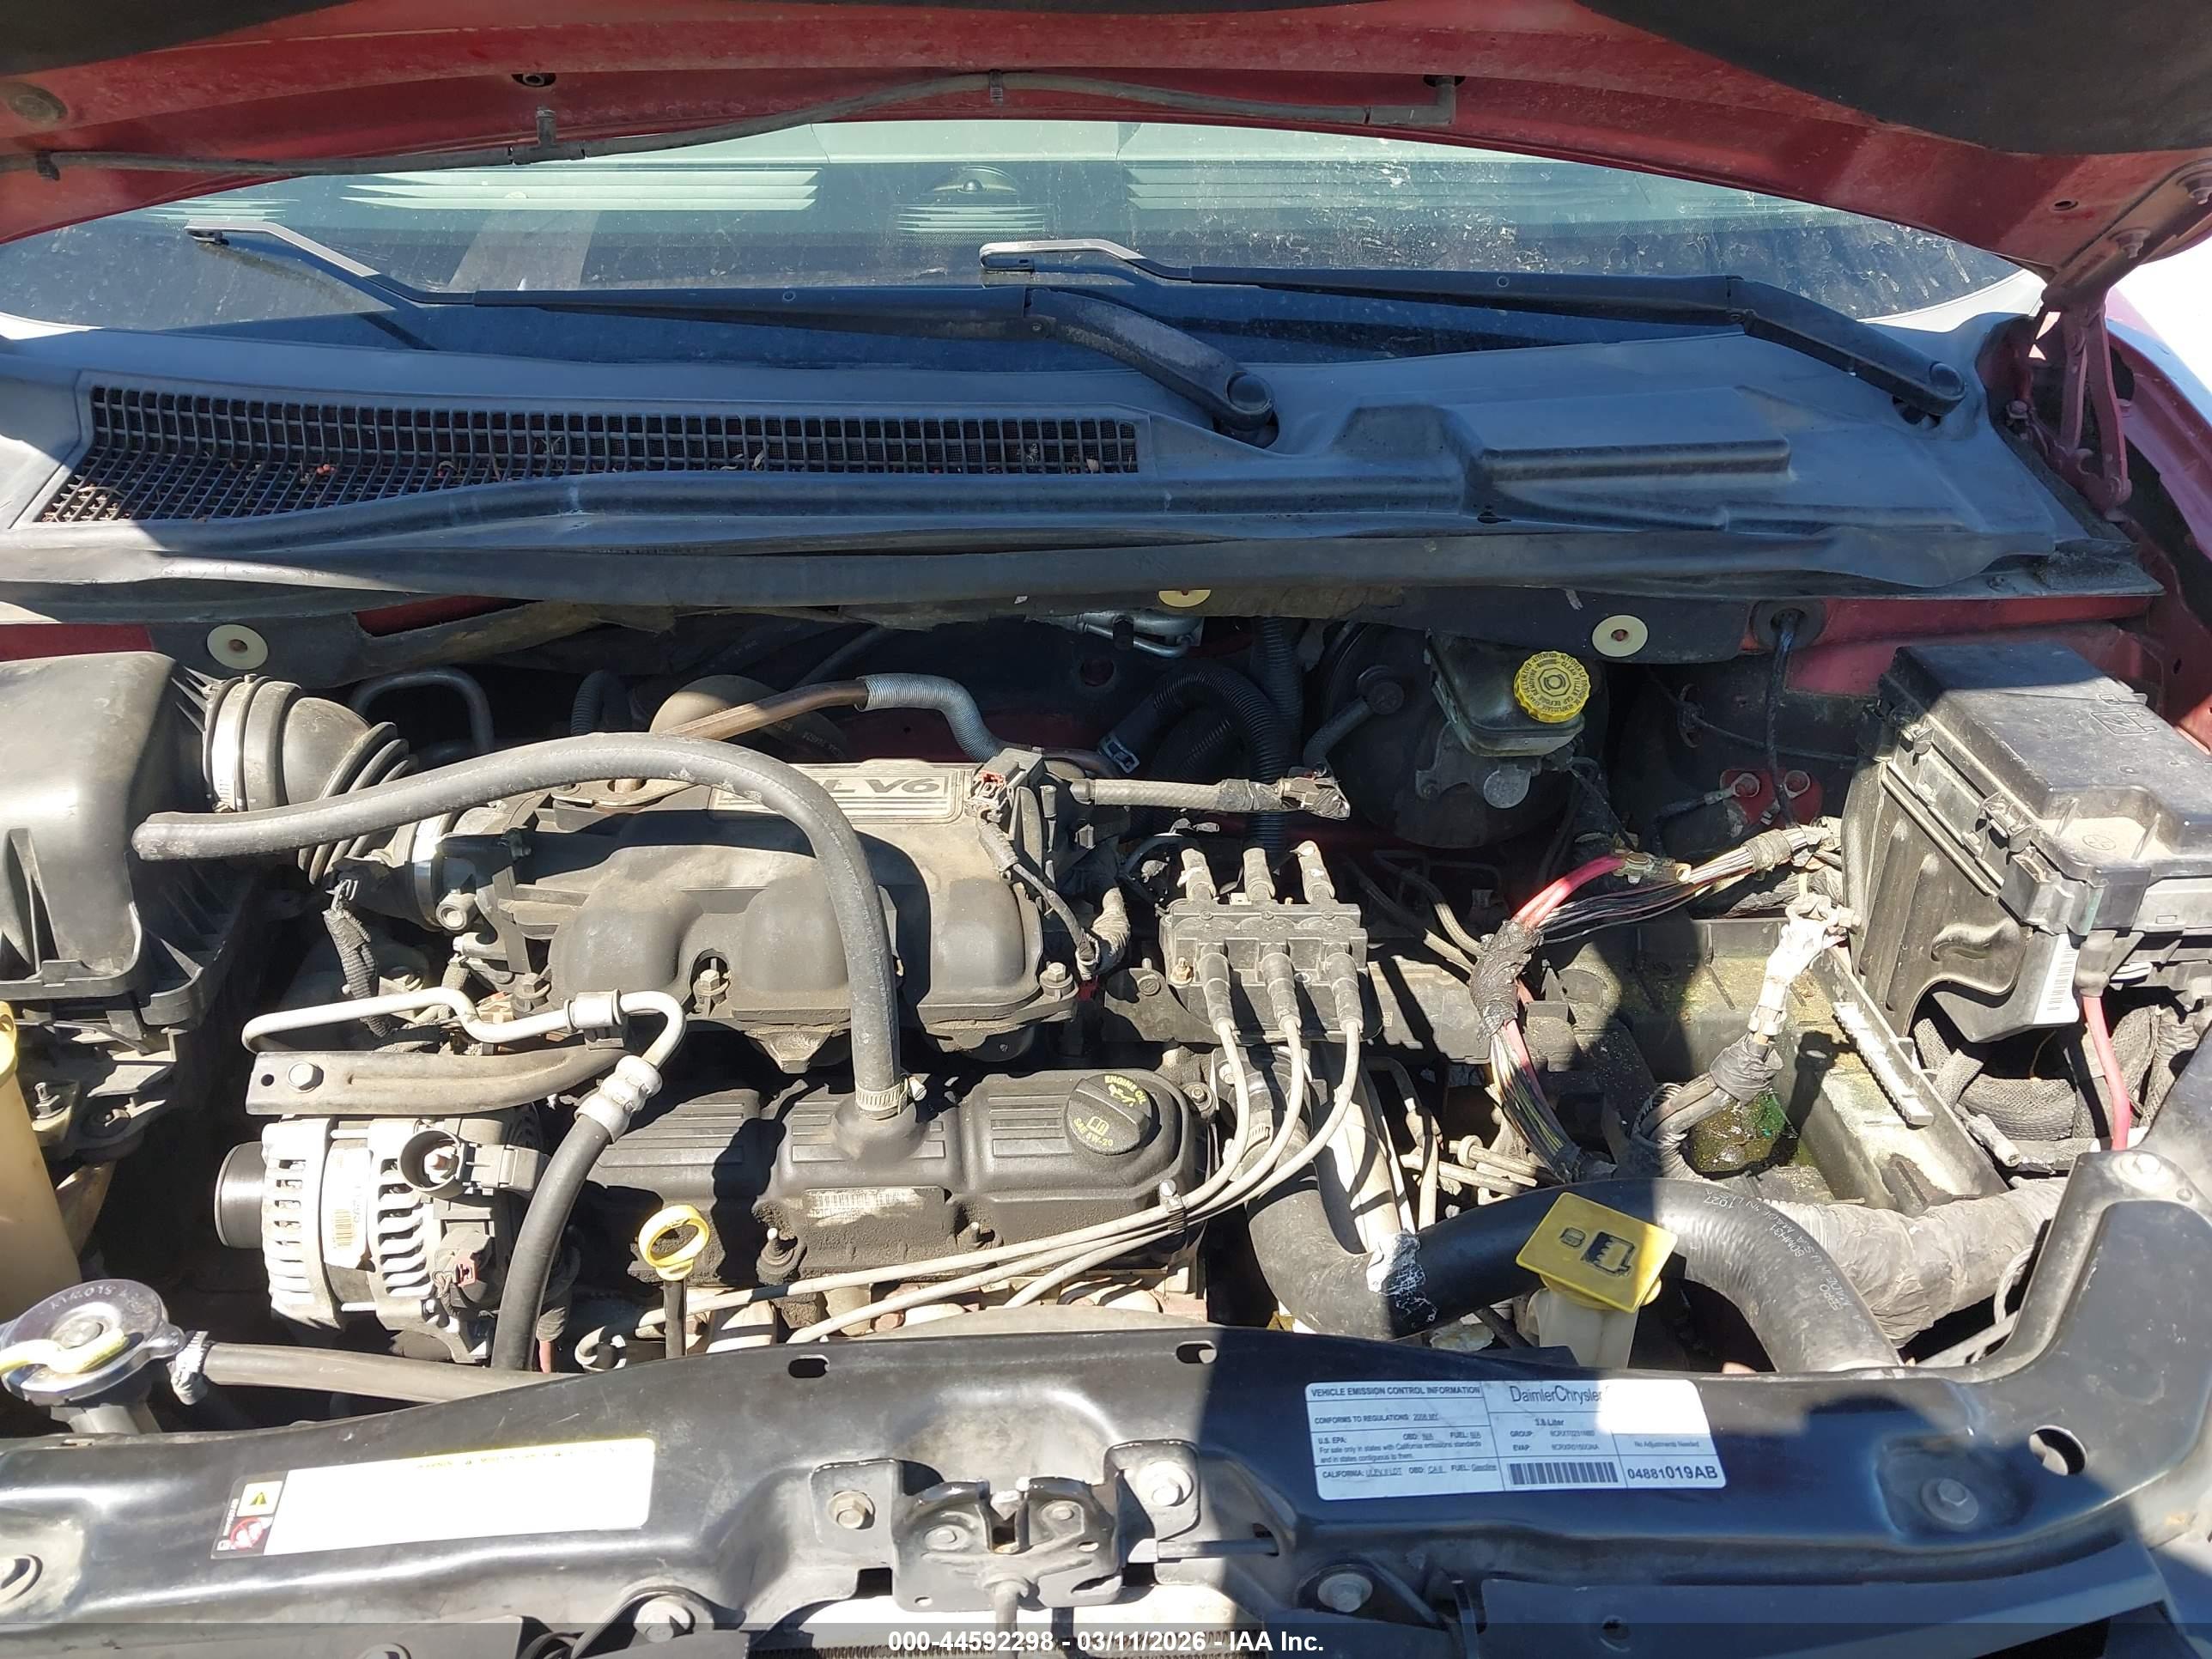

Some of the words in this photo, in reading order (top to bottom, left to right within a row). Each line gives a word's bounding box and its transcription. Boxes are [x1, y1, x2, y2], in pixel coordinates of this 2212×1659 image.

[865, 778, 940, 793] V6
[1104, 1075, 1137, 1091] ENGINE
[1135, 1090, 1146, 1105] OIL
[1073, 1117, 1089, 1133] SAE
[1085, 1132, 1114, 1146] 5W-20
[1311, 1388, 1345, 1396] VEHICLE
[1347, 1387, 1385, 1396] EMISSION
[1387, 1386, 1425, 1395] CONTROL
[1426, 1386, 1480, 1395] INFORMATION
[1510, 1385, 1601, 1405] DaimlerChrysler
[1395, 1442, 1423, 1450] California
[1627, 1465, 1718, 1479] 04881019AB
